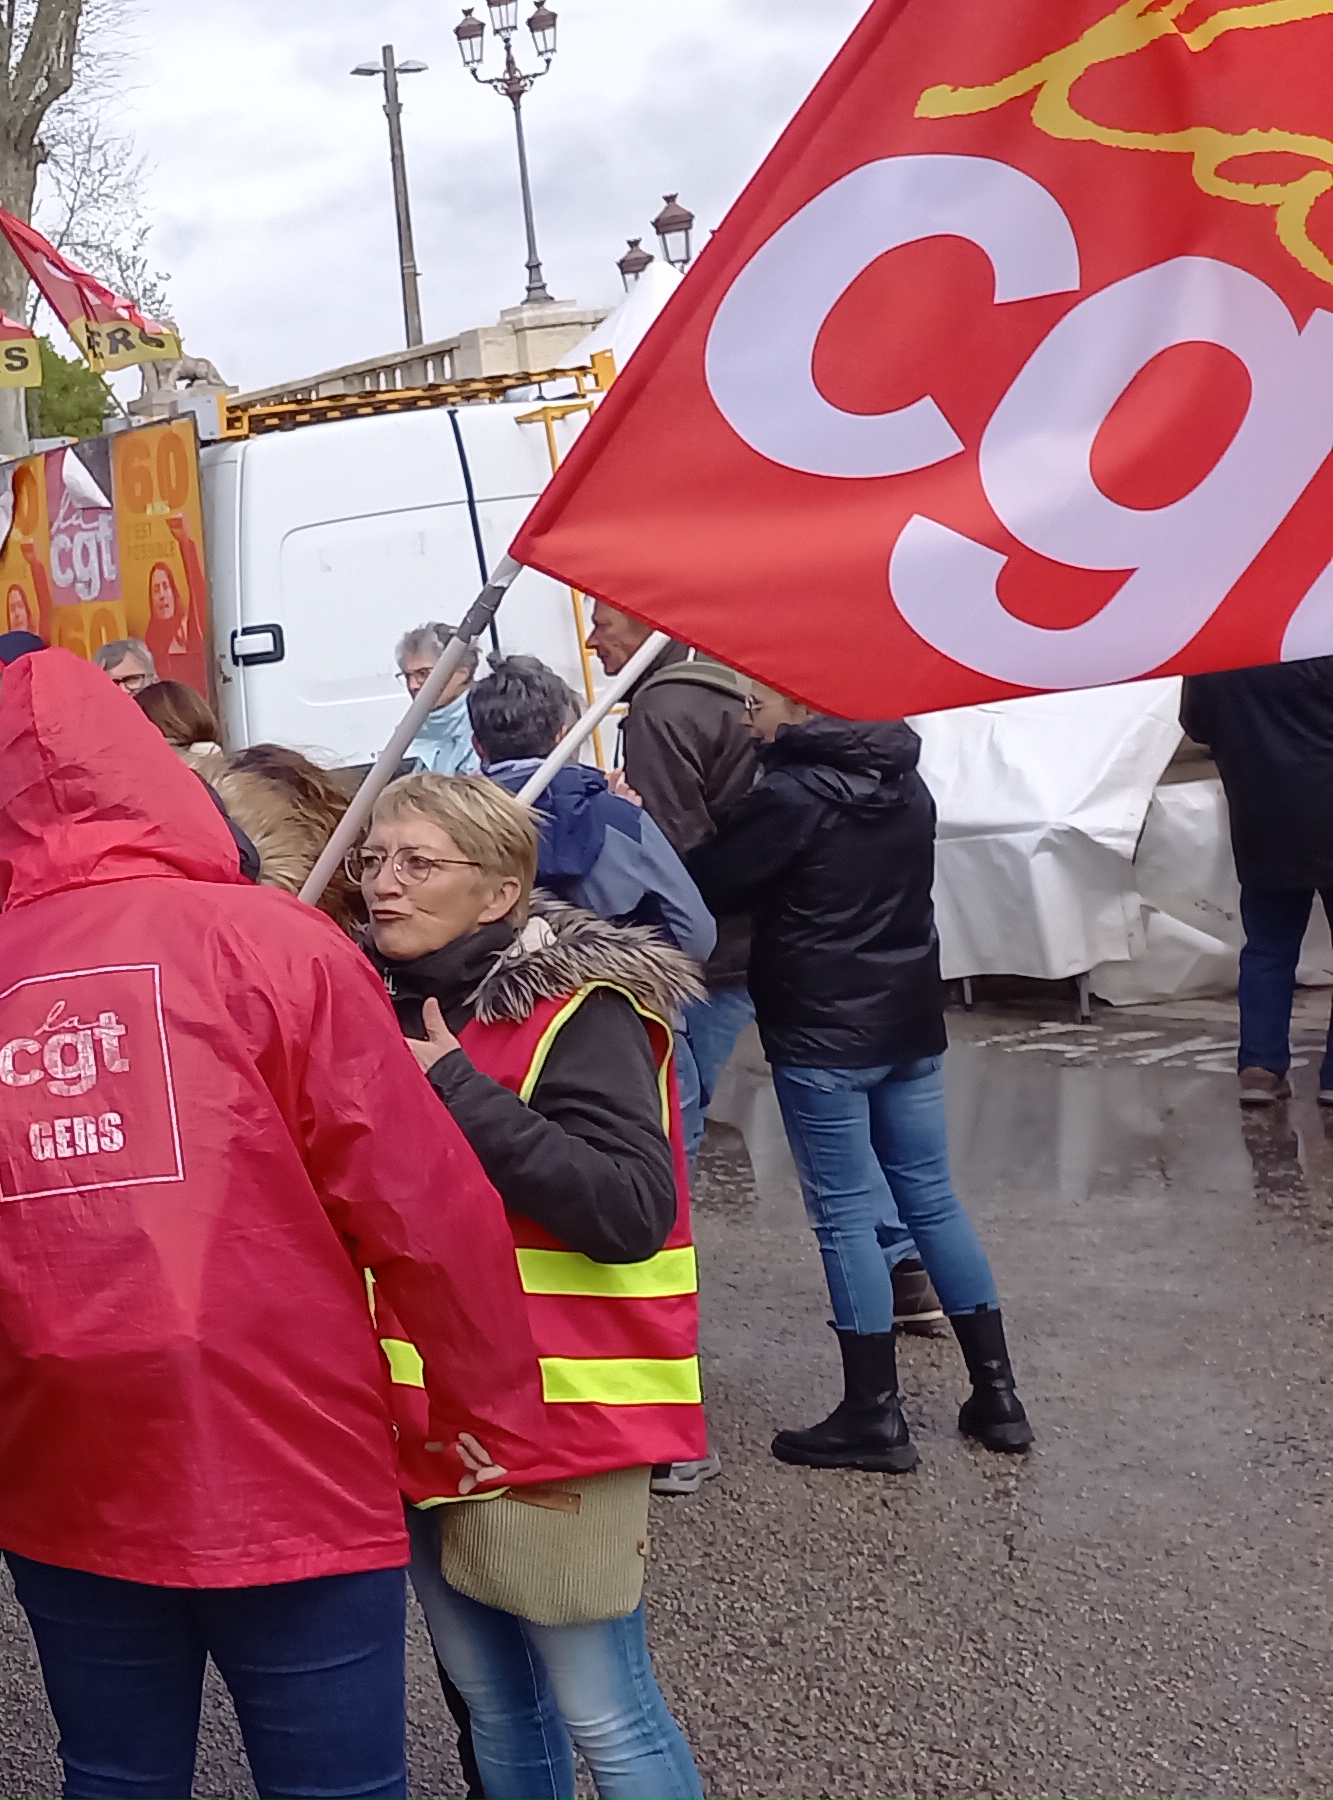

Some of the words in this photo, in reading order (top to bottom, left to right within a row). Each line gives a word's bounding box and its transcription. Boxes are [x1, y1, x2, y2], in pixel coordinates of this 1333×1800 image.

[705, 154, 1333, 689] cg
[121, 431, 190, 514] 60
[49, 512, 117, 601] cgt
[29, 1111, 126, 1162] GERS
